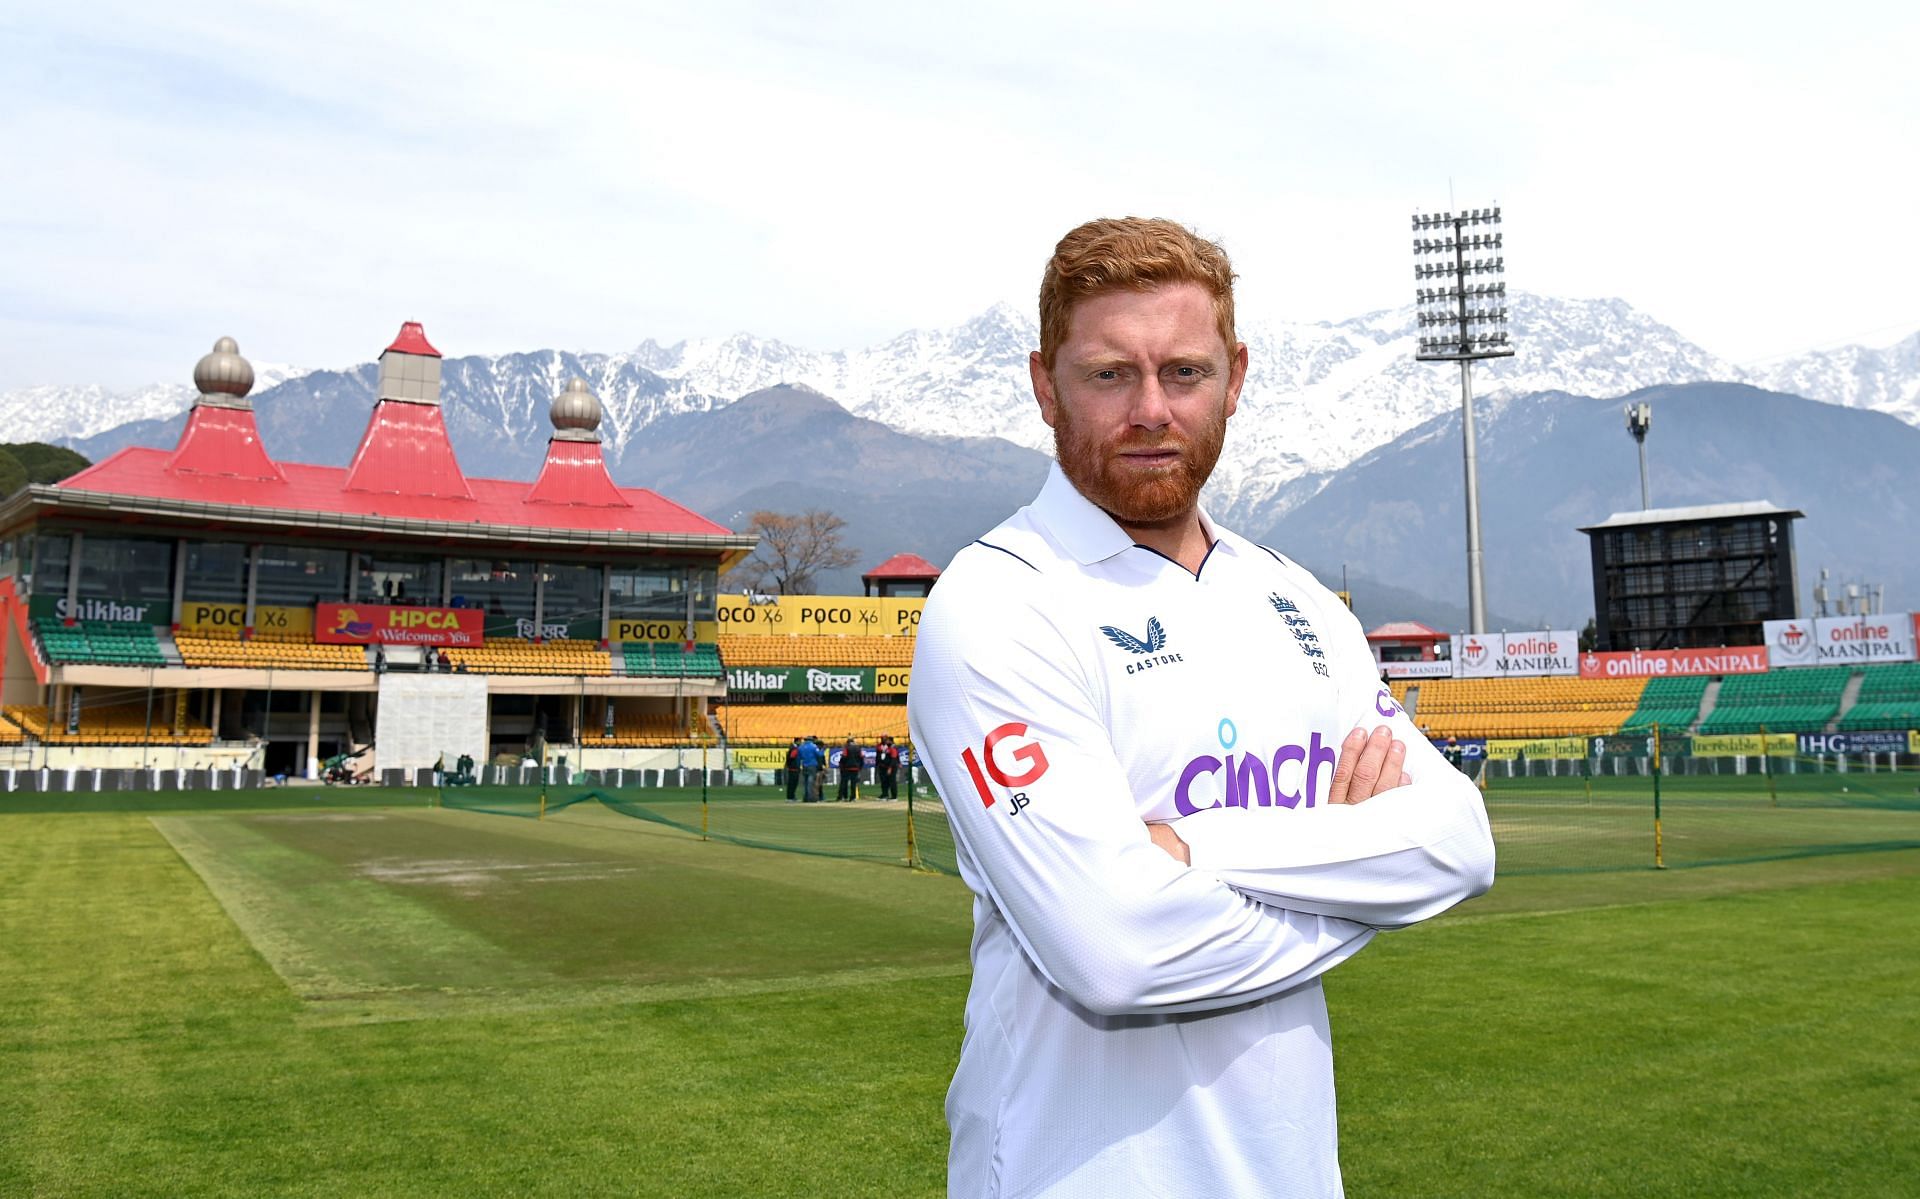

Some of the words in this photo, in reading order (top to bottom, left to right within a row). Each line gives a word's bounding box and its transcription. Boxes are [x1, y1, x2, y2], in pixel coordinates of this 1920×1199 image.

[264, 612, 287, 627] X6
[388, 610, 460, 629] HPCA
[717, 607, 755, 622] OCO
[762, 609, 783, 622] X6
[801, 608, 851, 623] POCO
[858, 610, 878, 624] X6
[898, 609, 922, 625] PO
[376, 628, 445, 642] Welcomes
[449, 631, 471, 644] You
[619, 623, 670, 639] POCO
[1831, 622, 1889, 641] online
[1507, 638, 1558, 656] online
[1819, 642, 1906, 657] MANIPAL
[1126, 653, 1184, 675] CASTORE
[1312, 661, 1330, 678] 652
[1380, 664, 1409, 674] nline
[1409, 666, 1449, 674] MANIPAL
[1496, 656, 1573, 671] MANIPAL
[1606, 653, 1668, 675] online
[1672, 654, 1766, 673] MANIPAL
[727, 669, 788, 690] hikhar
[806, 668, 864, 692] शिखर
[878, 673, 910, 687] POC
[1765, 737, 1795, 751] ndia
[1800, 735, 1846, 752] IHG
[1850, 734, 1895, 743] HOTELS
[1850, 743, 1904, 752] RESORTS
[735, 750, 785, 764] Incredib
[961, 722, 1050, 809] IG
[1174, 717, 1336, 817] cinch
[1009, 792, 1030, 816] JB
